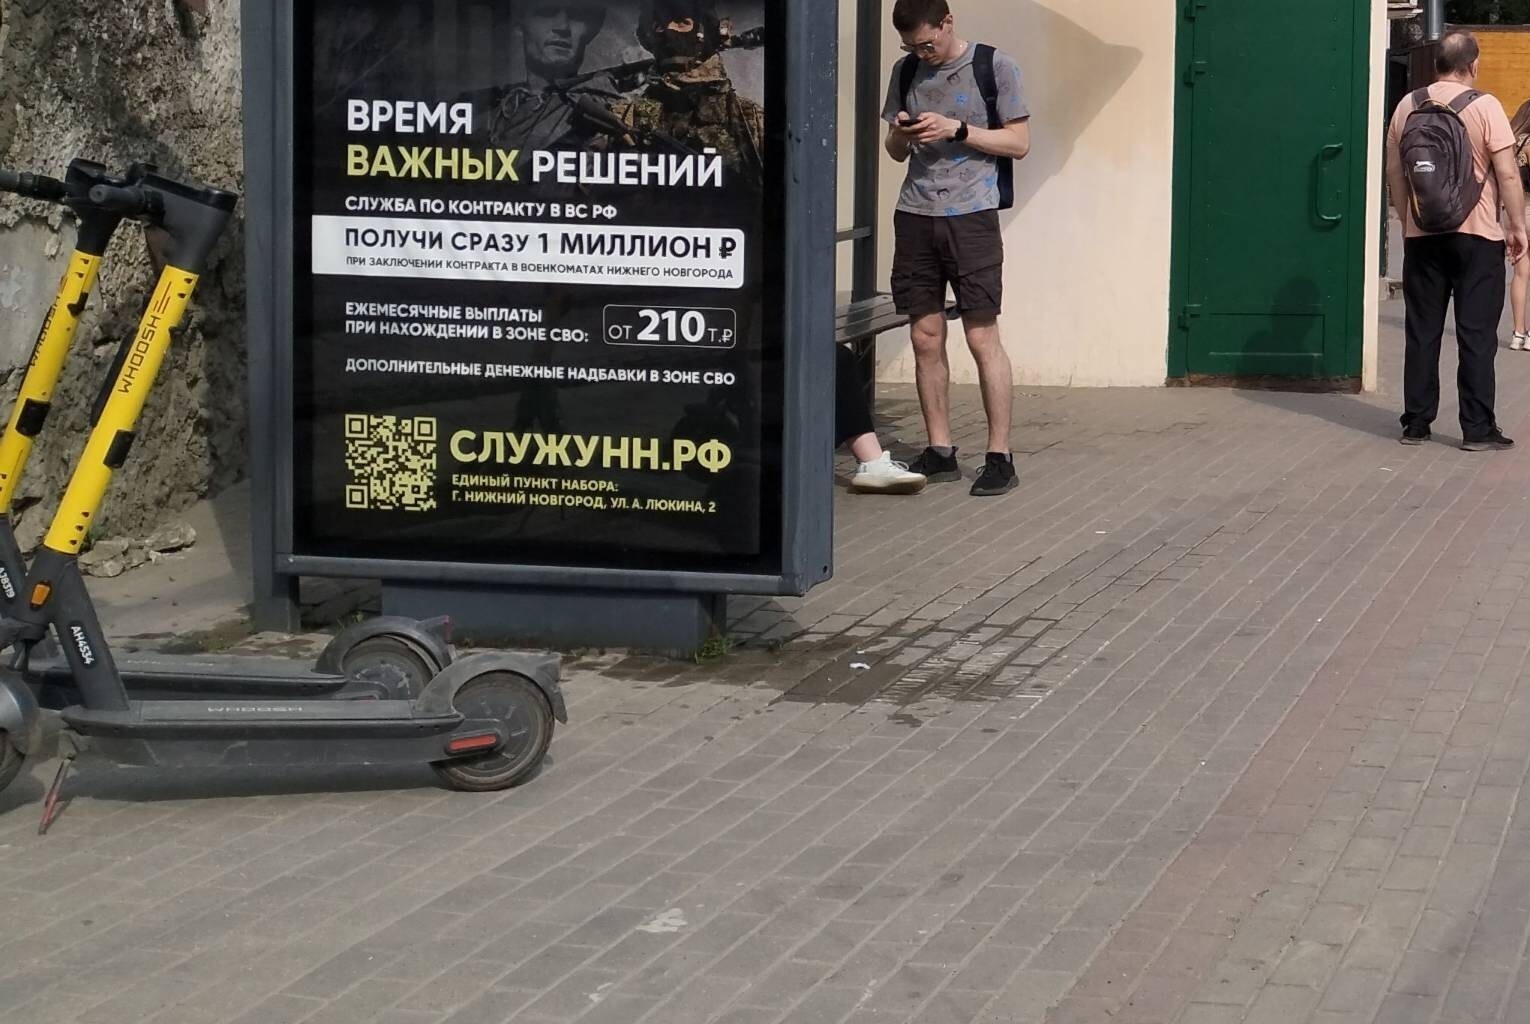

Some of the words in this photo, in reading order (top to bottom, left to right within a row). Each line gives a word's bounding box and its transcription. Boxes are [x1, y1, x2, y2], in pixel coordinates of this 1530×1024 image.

[347, 98, 473, 135] ВРЕМЯ
[346, 144, 520, 183] ВАЖНЫХ
[532, 147, 723, 187] РЕШЕНИЙ
[345, 196, 416, 213] СЛУЖБА
[420, 198, 445, 214] ПО
[448, 200, 546, 217] КОНТРАКТУ
[550, 204, 560, 218] В
[565, 204, 588, 219] ВС
[592, 204, 618, 220] РФ
[345, 227, 443, 250] ПОЛУЧИ
[451, 232, 530, 253] СРАЗУ
[537, 233, 549, 254] 1
[559, 232, 711, 259] МИЛЛИОН
[346, 256, 366, 267] ПРИ
[369, 257, 443, 269] ЗАКЛЮЧЕНИИ
[446, 260, 509, 272] КОНТРАКТА
[511, 262, 519, 272] В
[521, 262, 604, 275] ВОЕНКОМАТАХ
[606, 265, 660, 277] НИЖНЕГО
[663, 268, 734, 280] НОВГОРОДА
[345, 302, 461, 320] ЕЖЕМЕСЯЧНЫЕ
[465, 307, 543, 322] ВЫПЛАТЫ
[608, 325, 633, 340] ОТ
[637, 309, 706, 343] 210
[345, 320, 376, 334] ПРИ
[379, 321, 489, 339] НАХОЖДЕНИИ
[493, 327, 502, 339] В
[505, 327, 547, 341] ЗОНЕ
[550, 328, 589, 343] СВО:
[118, 314, 162, 394] WHOOSH
[345, 358, 481, 376] ДОПОЛНИТЕЛЬНЫЕ
[484, 363, 564, 380] ДЕНЕЖНЫЕ
[568, 367, 647, 382] НАДБАВКИ
[650, 370, 659, 382] В
[662, 370, 700, 384] ЗОНЕ
[703, 371, 736, 386] СВО
[450, 429, 732, 473] СЛУЖУНН.РФ
[452, 473, 510, 487] ЕДИНЫЙ
[513, 476, 557, 490] ПУНКТ
[561, 478, 619, 493] НАБОРА:
[452, 490, 462, 502] Г.
[465, 490, 526, 504] НИЖНИЙ
[529, 494, 607, 510] НОВГОРОД,
[610, 497, 629, 510] УЛ.
[632, 498, 643, 510] А.
[646, 498, 706, 514] ЛЮКИНА,
[708, 501, 716, 513] 2
[70, 626, 96, 666] AH4534
